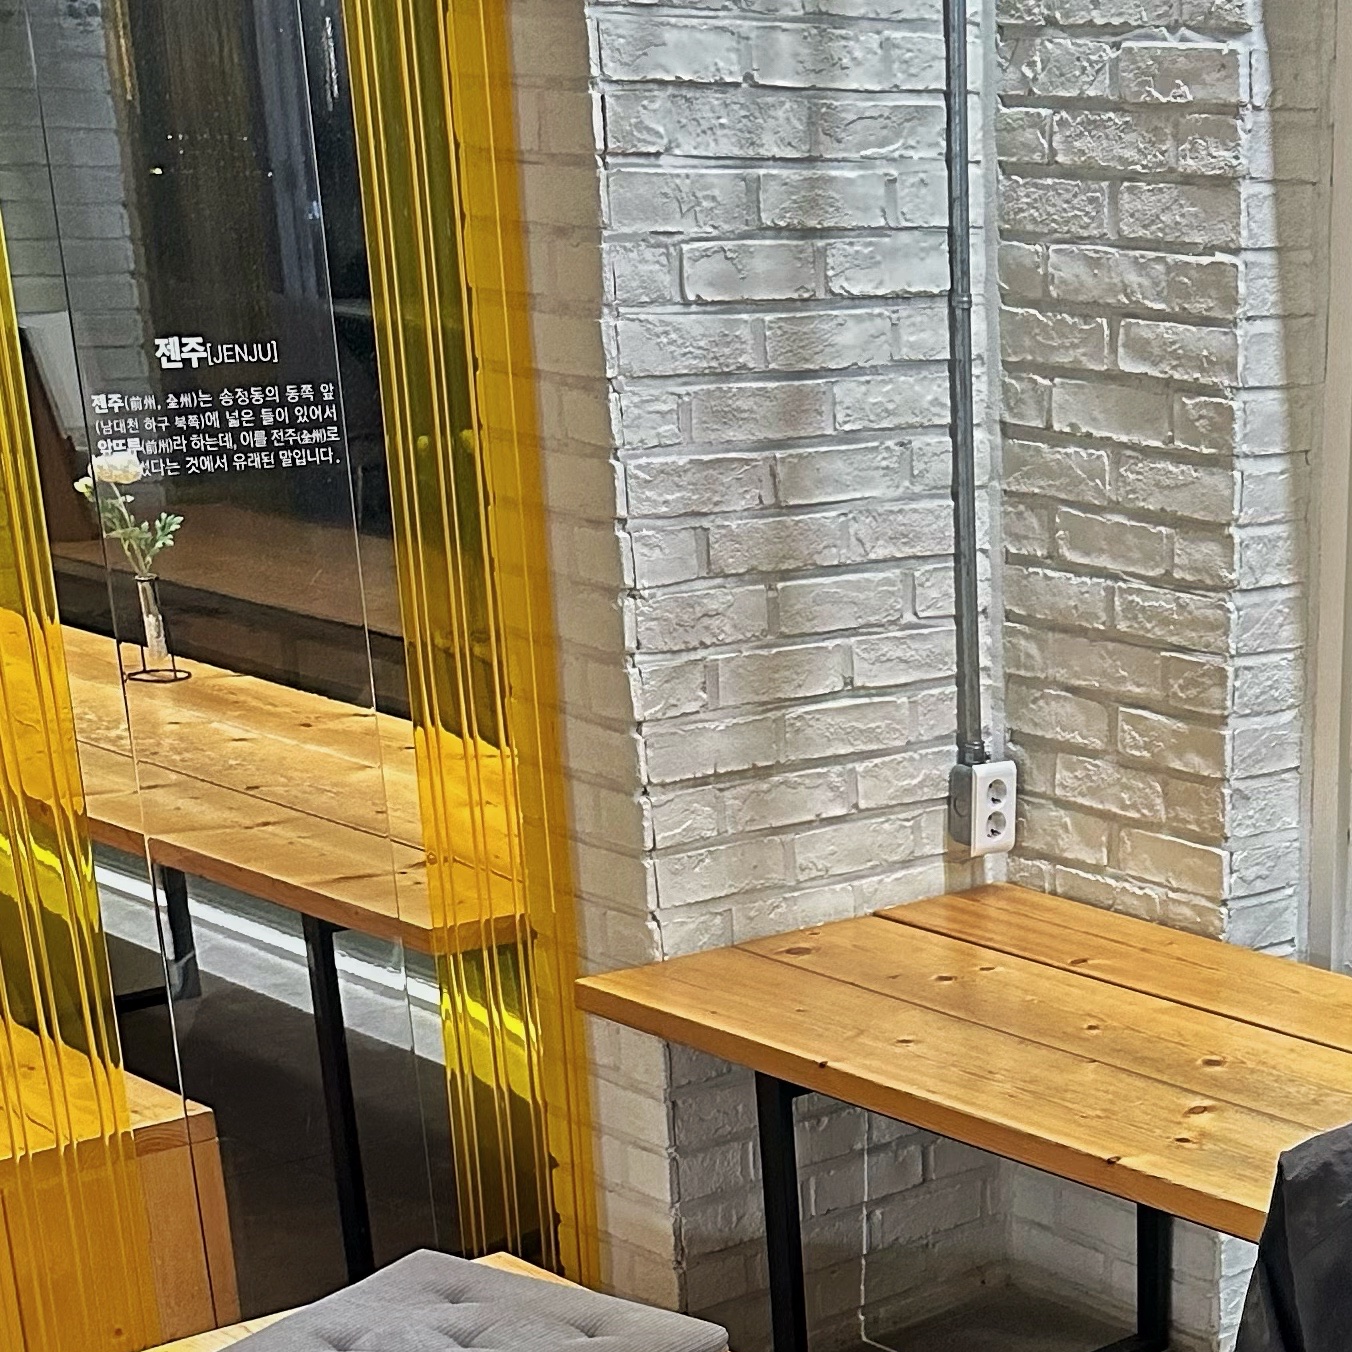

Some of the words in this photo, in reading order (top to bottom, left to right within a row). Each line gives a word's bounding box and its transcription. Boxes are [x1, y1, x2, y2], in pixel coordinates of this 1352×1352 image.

[219, 385, 279, 406] 송정동의
[285, 384, 314, 402] 동쪽
[320, 382, 335, 400] 앞
[95, 417, 140, 436] (남대천
[143, 416, 171, 432] 하구
[174, 410, 220, 430] 북쪽)에
[225, 408, 256, 427] 넓은
[260, 406, 290, 425] 들이
[294, 403, 338, 423] 있어서
[189, 431, 238, 452] 하는데,
[240, 430, 268, 448] 이를
[185, 452, 228, 474] 것에서
[232, 451, 276, 470] 유래된
[278, 446, 341, 468] 말입니다.
